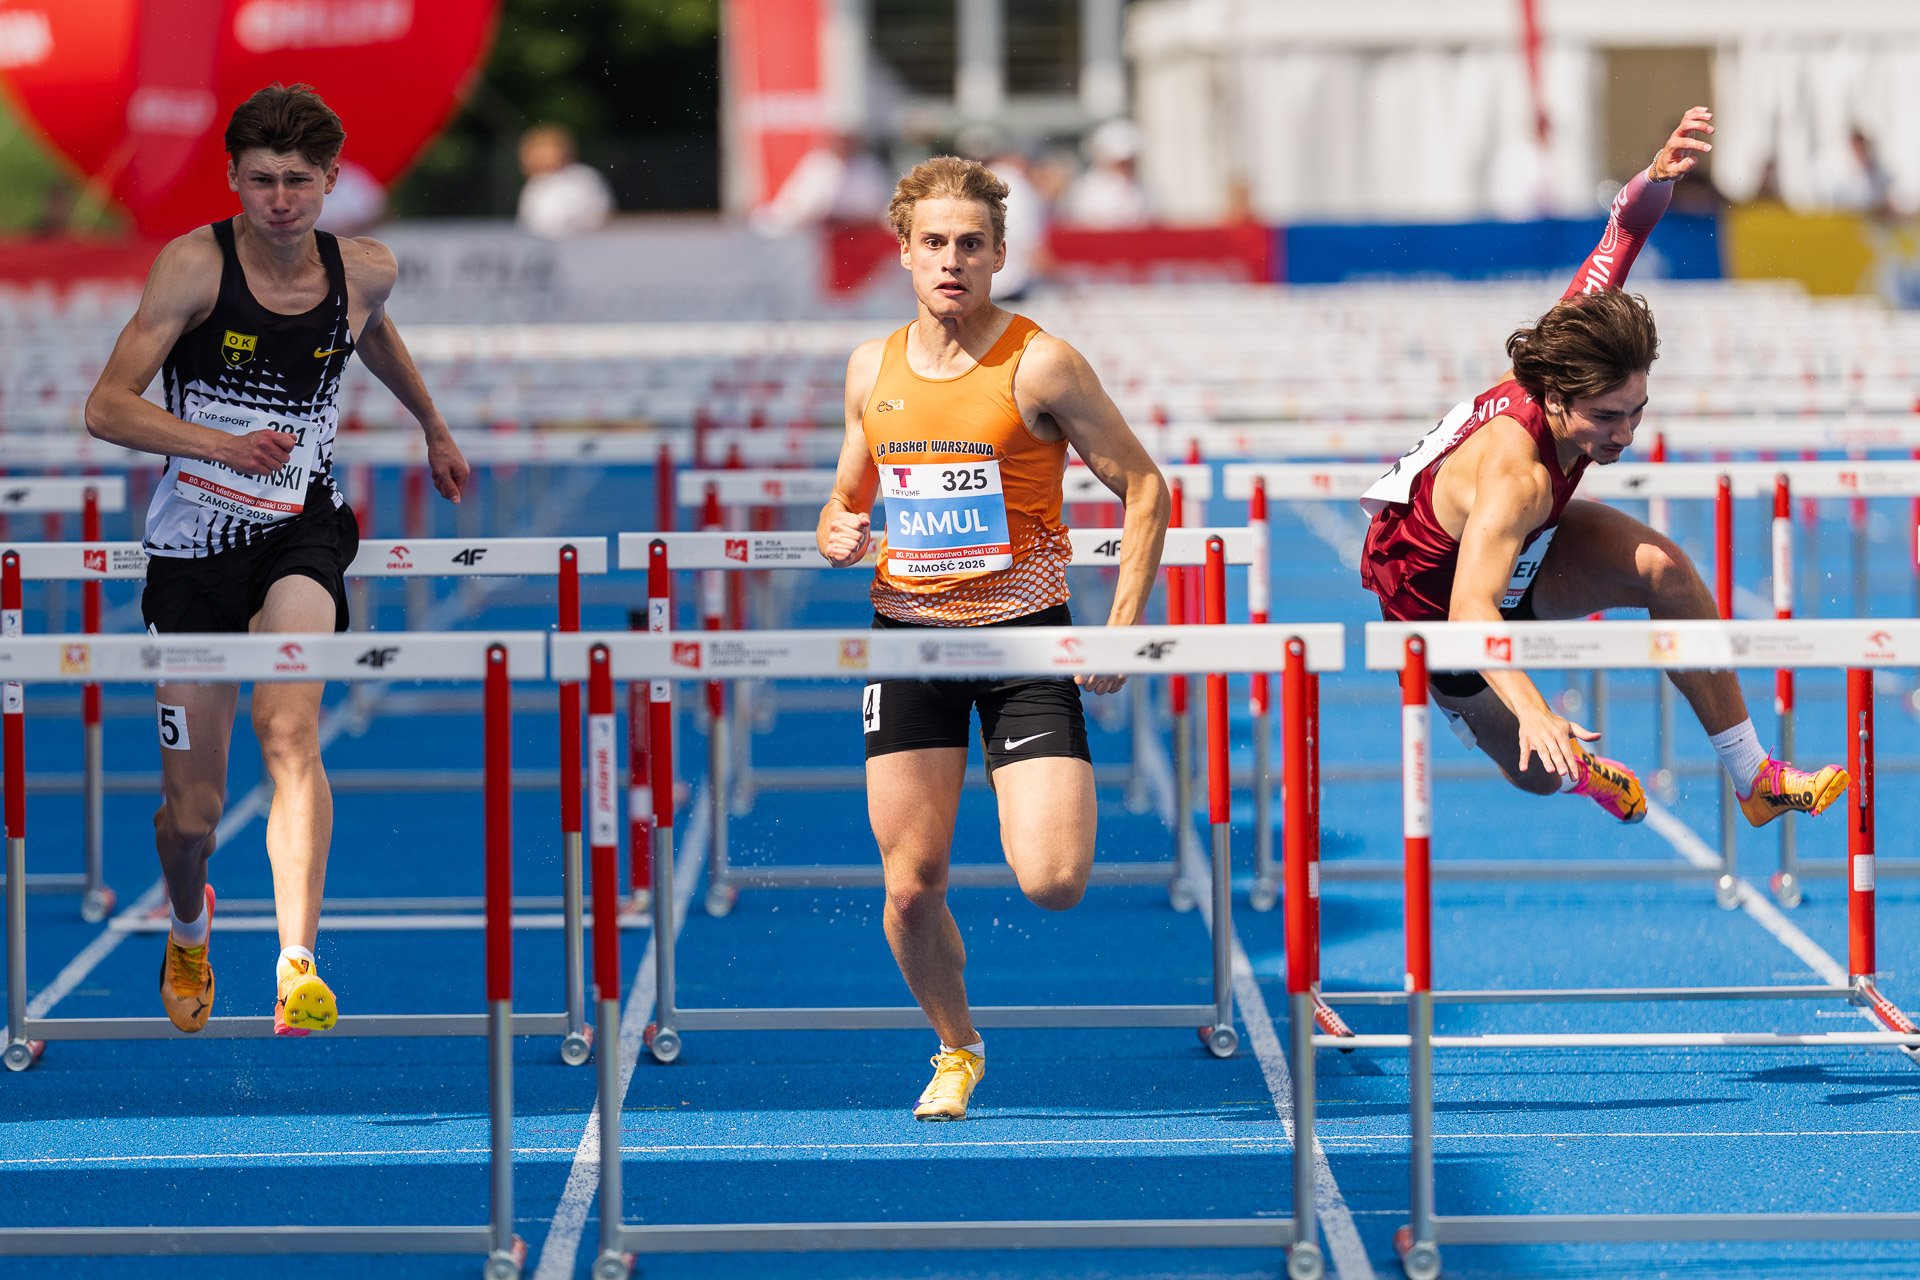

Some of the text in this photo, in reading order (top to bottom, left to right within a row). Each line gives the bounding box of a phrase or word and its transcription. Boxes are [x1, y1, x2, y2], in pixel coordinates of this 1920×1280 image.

[231, 351, 240, 361] S
[876, 398, 905, 413] esa
[198, 411, 251, 428] TVP SPORT
[876, 440, 995, 457] LA Basket WARSZAWA
[941, 468, 988, 492] 325
[188, 476, 200, 486] 80.
[200, 480, 215, 492] PZLA
[215, 487, 255, 505] Mistrzostwa
[255, 499, 276, 509] Polski
[891, 488, 921, 497] TRYUMF
[198, 492, 274, 521] ZAMOŚĆ 2026
[899, 508, 989, 536] SAMUL
[452, 548, 488, 566] 4F
[895, 546, 1000, 559] 80. PZLA Mistrzostwa Polski U20
[908, 559, 986, 573] ZAMOŚĆ 2026
[356, 647, 400, 669] 4F
[1136, 639, 1177, 660] 4F
[864, 688, 874, 728] 4
[161, 707, 180, 746] 5
